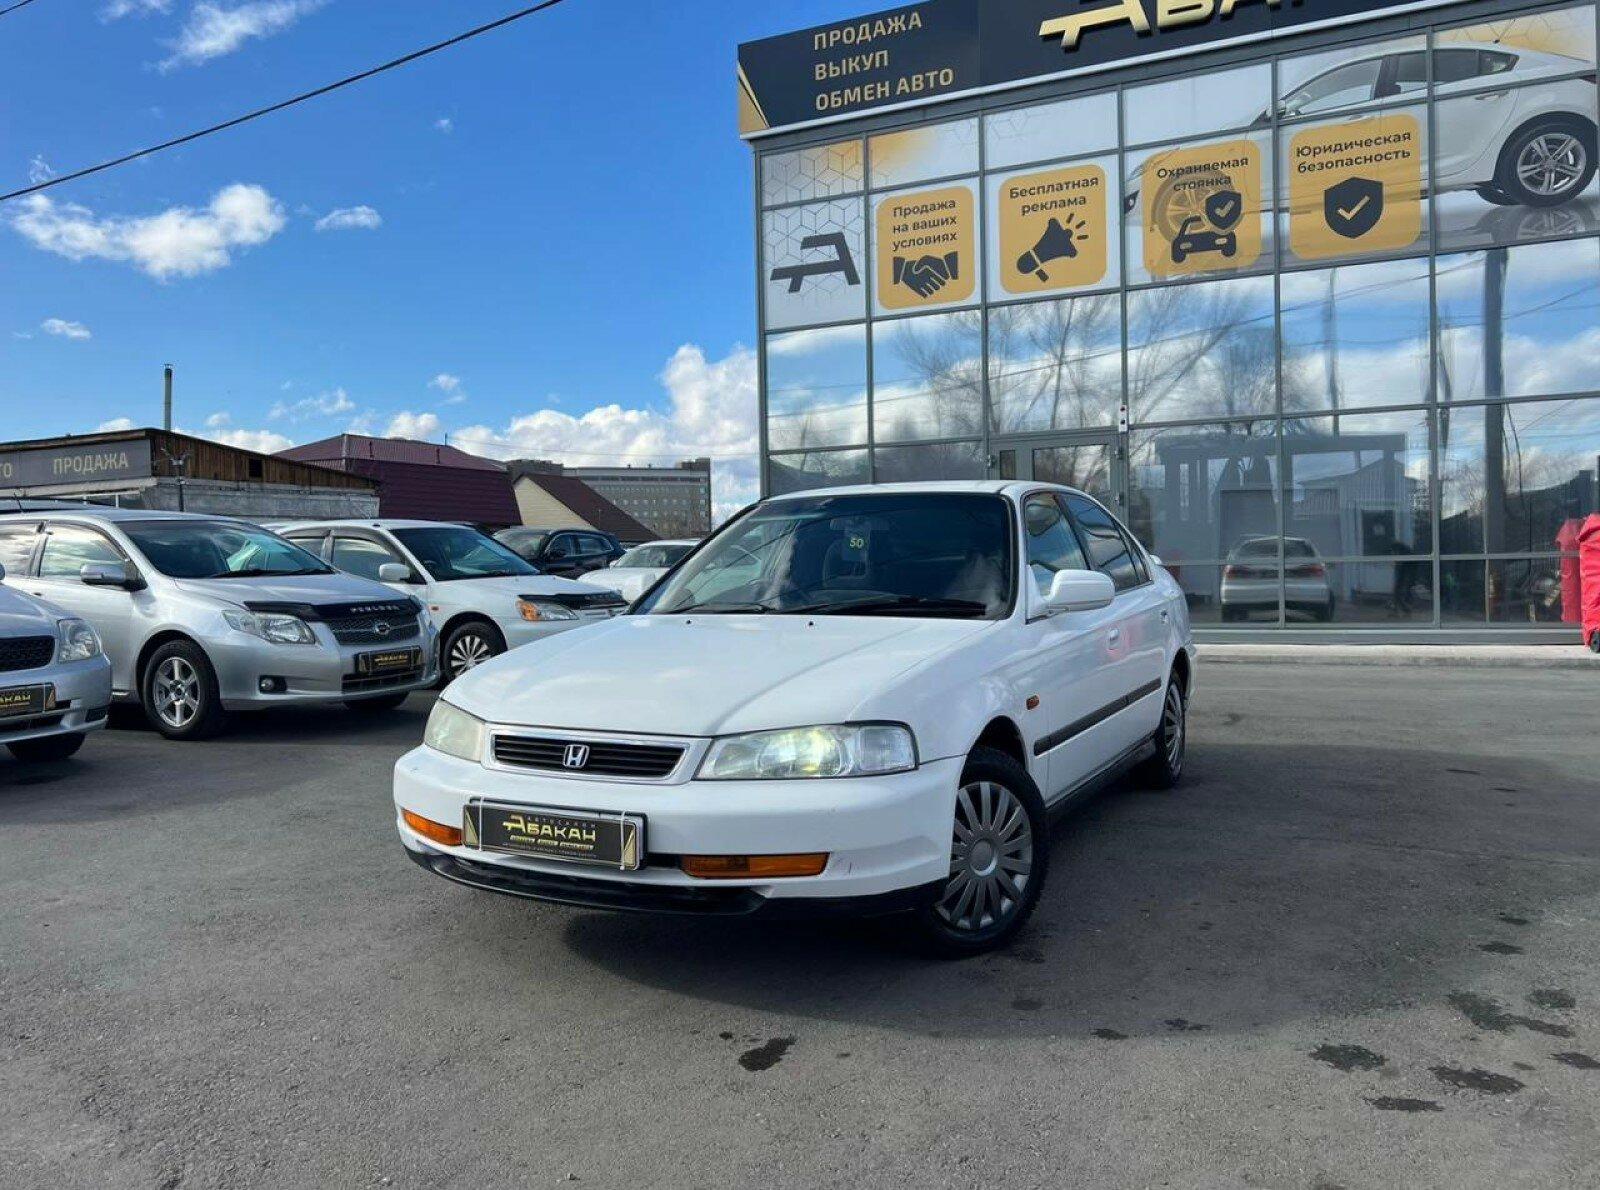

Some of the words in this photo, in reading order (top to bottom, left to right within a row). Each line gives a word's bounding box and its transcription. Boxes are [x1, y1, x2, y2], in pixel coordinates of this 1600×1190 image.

[814, 11, 922, 50] ПРОДАЖА
[814, 50, 889, 81] ВЫКУП
[815, 81, 890, 111] ОБМЕН
[895, 68, 954, 95] АВТО
[1296, 131, 1412, 158] Юридическая
[1157, 156, 1249, 179] Охраняемая
[1297, 149, 1411, 173] безопасность
[1009, 177, 1099, 199] Бесплатная
[1173, 175, 1232, 191] стоянка
[893, 199, 956, 218] Продажа
[1021, 195, 1087, 216] реклама
[893, 221, 908, 234] на
[912, 216, 957, 231] ваших
[893, 233, 957, 251] условиях
[53, 452, 129, 475] ПРОДАЖА
[502, 813, 596, 842] АБАКАН
